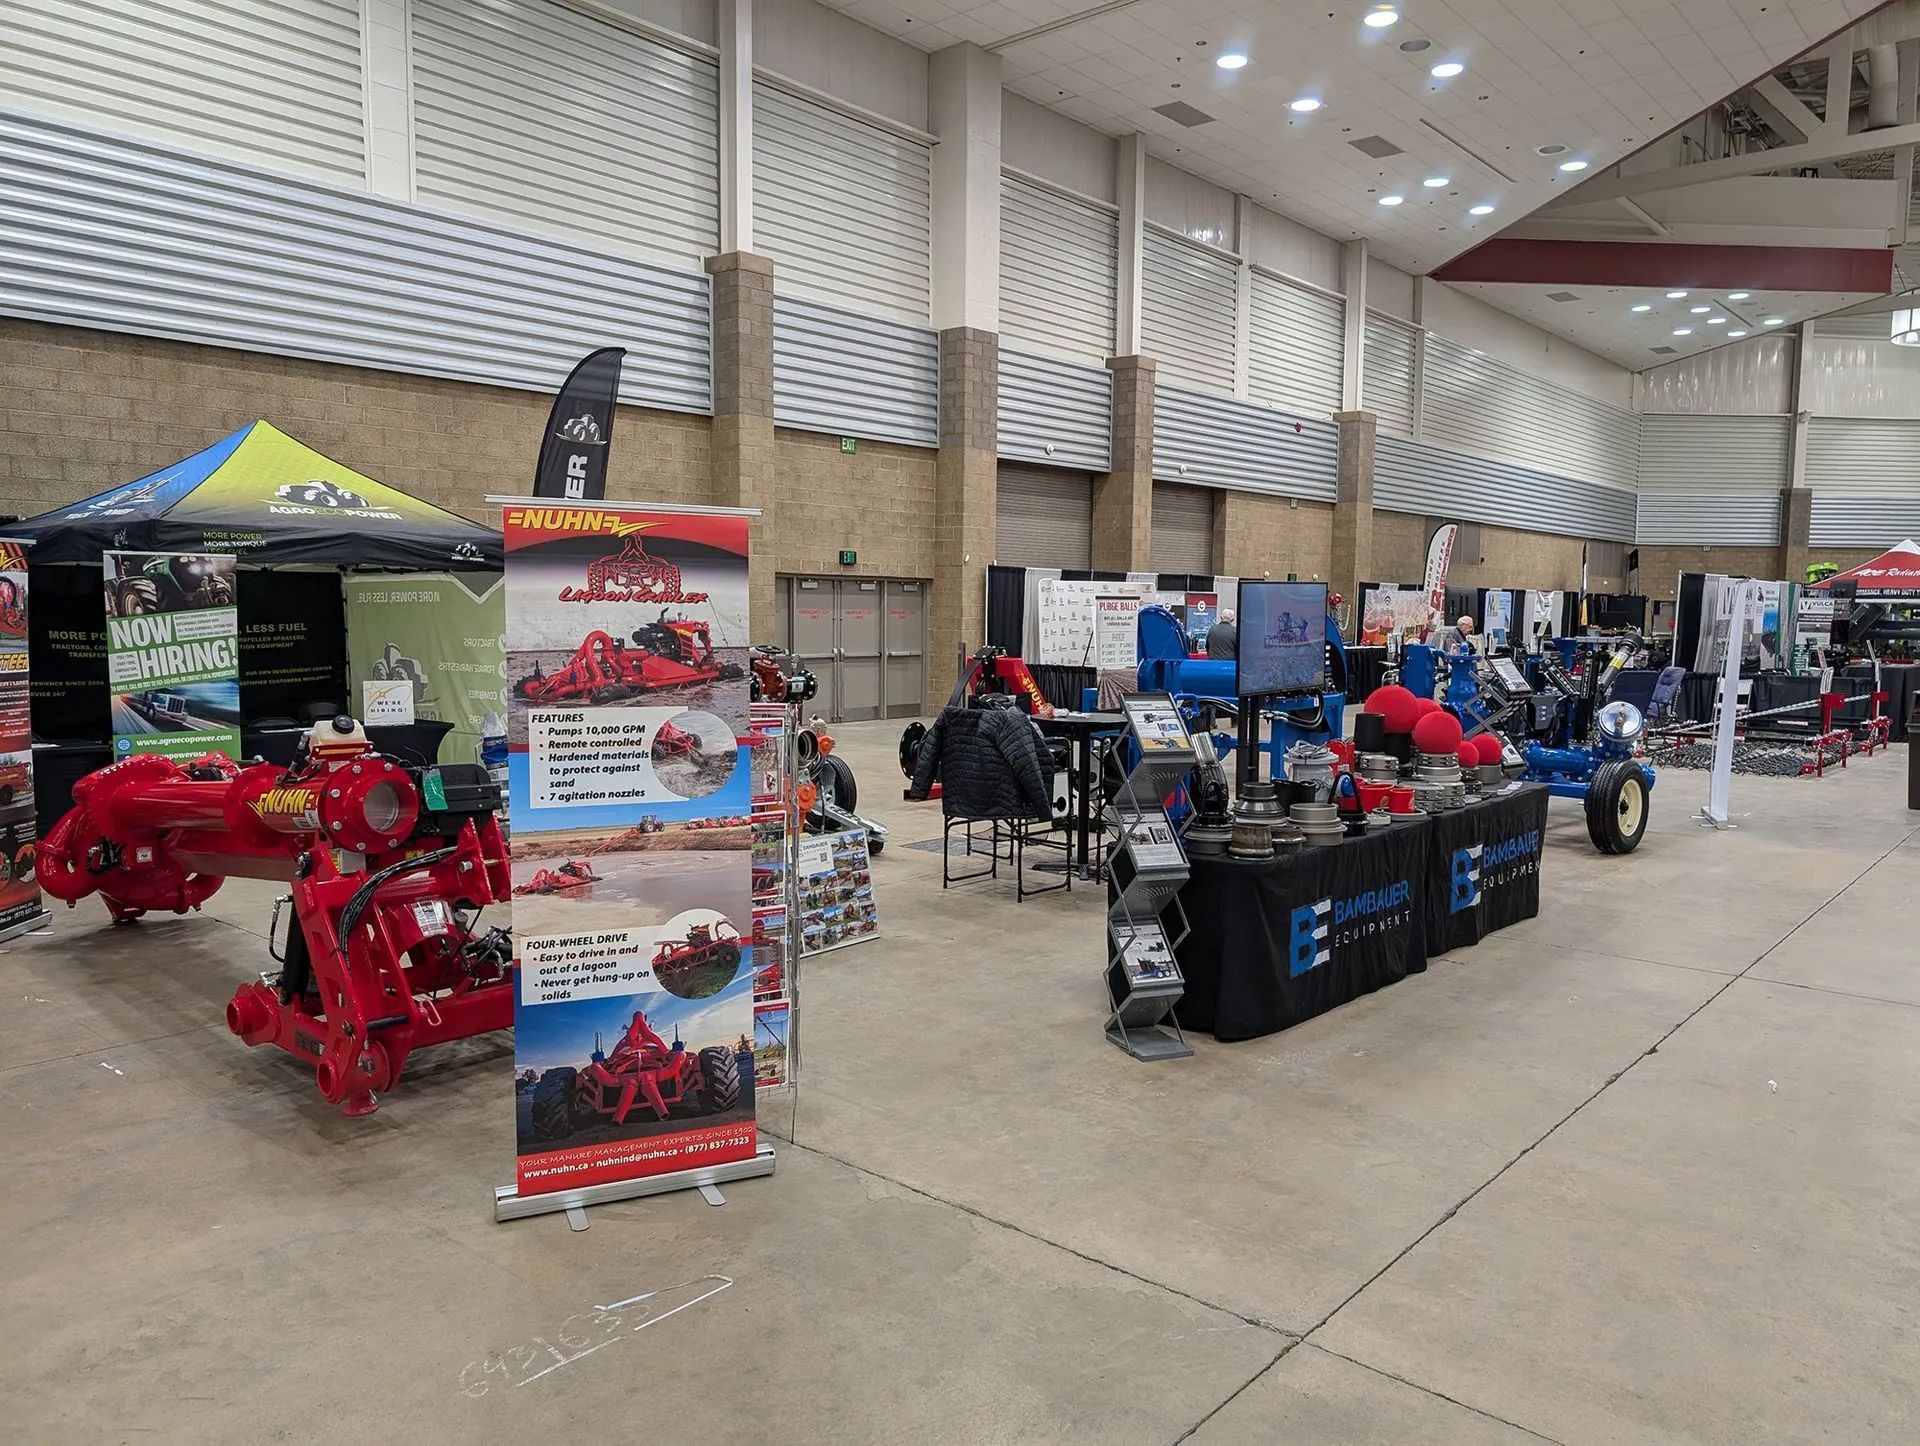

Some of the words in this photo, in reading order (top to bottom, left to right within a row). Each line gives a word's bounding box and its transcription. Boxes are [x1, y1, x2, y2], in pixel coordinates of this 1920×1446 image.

[842, 438, 856, 450] EXIT
[564, 454, 588, 499] ER
[269, 505, 403, 520] AGROECOPOWER
[521, 509, 603, 531] NUHN
[203, 531, 229, 540] MORE
[230, 532, 262, 541] POWER
[231, 540, 268, 548] TORQUE
[558, 586, 633, 604] LAGOON
[632, 586, 710, 604] CRAWLER
[1100, 602, 1119, 612] PURGE
[1120, 602, 1138, 612] BALLS
[48, 630, 86, 640] MORE
[110, 615, 172, 650] NOW
[246, 624, 276, 633] LESS
[278, 622, 308, 632] FUEL
[138, 637, 238, 679] HIRING!
[531, 713, 584, 724] FEATURES
[548, 727, 582, 738] Pumps
[586, 726, 620, 736] 10,000
[622, 725, 646, 734] GPM
[136, 734, 232, 746] www.agroecopower.com
[548, 740, 588, 750] Remote
[590, 738, 642, 748] controlled
[548, 752, 599, 762] Hardened
[602, 750, 650, 760] materials
[550, 767, 560, 776] to
[562, 766, 600, 777] protect
[602, 764, 640, 775] against
[550, 778, 576, 788] sand
[264, 789, 312, 813] NUHN
[549, 792, 556, 802] 7
[558, 790, 606, 803] agitation
[608, 788, 646, 799] nozzles
[1334, 880, 1410, 925] BAMBAUER
[1335, 910, 1410, 947] EQUIPMENT
[526, 936, 594, 950] FOUR-WHEEL
[596, 933, 628, 944] DRIVE
[540, 953, 564, 963] Easy
[566, 952, 576, 960] to
[578, 948, 605, 958] drive
[607, 948, 616, 956] in
[619, 944, 638, 954] and
[540, 967, 557, 976] out
[560, 964, 571, 974] of
[581, 961, 617, 972] lagoon
[540, 977, 572, 988] Never
[574, 976, 590, 986] get
[592, 972, 634, 983] hung-up
[541, 990, 572, 1001] solids
[520, 1158, 548, 1170] YOUR
[550, 1150, 592, 1164] MANURE
[594, 1140, 661, 1156] MANAGEMENT
[663, 1132, 704, 1146] EXPERTS
[706, 1129, 734, 1140] SINCE
[734, 1125, 754, 1136] 1902
[524, 1162, 588, 1179] www.nuhn.ca
[596, 1148, 678, 1168] nuhnind@nuhn.ca
[684, 1142, 708, 1156] (877)
[709, 1136, 750, 1150] 837-7323
